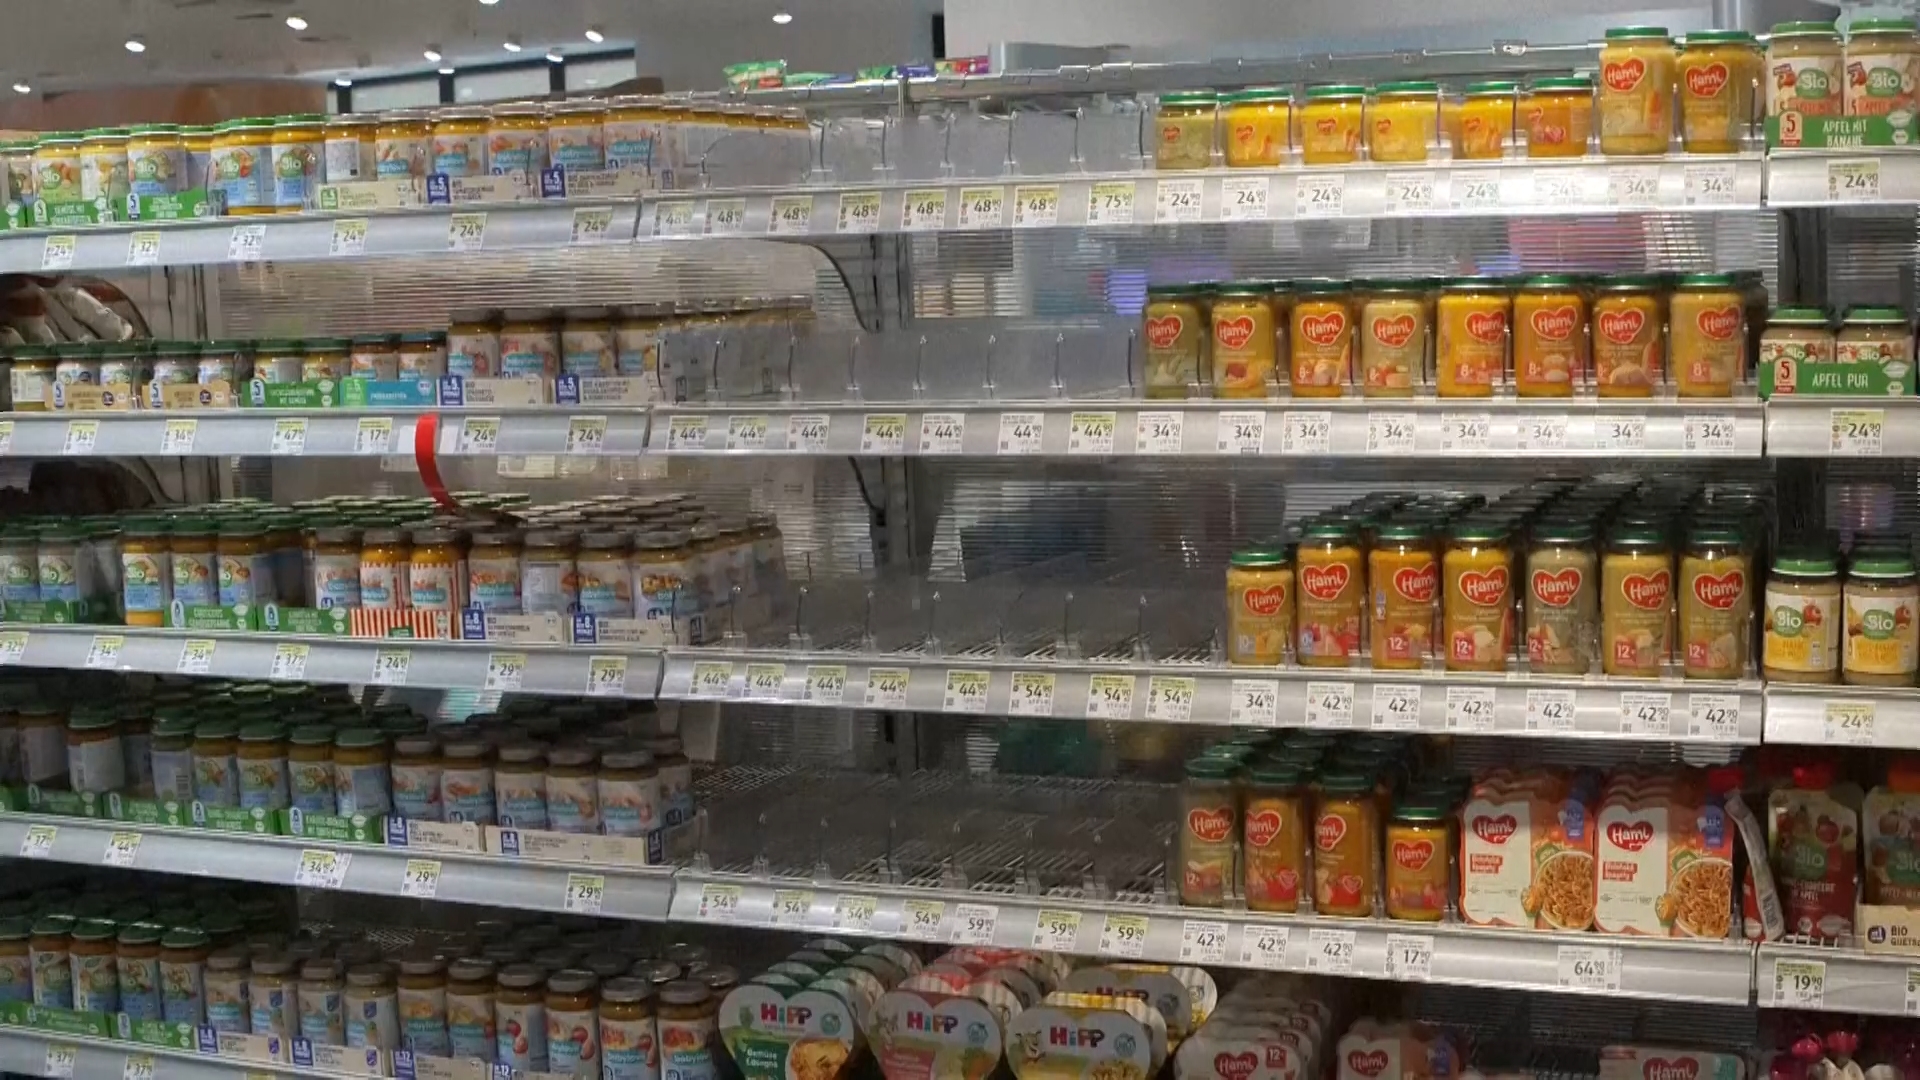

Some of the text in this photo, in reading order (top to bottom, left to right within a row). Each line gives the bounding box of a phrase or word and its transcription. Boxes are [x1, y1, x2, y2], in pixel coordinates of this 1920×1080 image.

[1608, 64, 1640, 84] Hami
[1689, 71, 1724, 91] Hami
[1871, 70, 1900, 89] Bio
[1786, 113, 1796, 134] 5
[1822, 120, 1850, 134] APFEL
[1306, 320, 1340, 337] Hami
[1377, 322, 1410, 338] Hami
[1538, 314, 1573, 332] Hami
[1604, 318, 1638, 334] Hami
[1780, 361, 1790, 379] 5
[1812, 374, 1868, 388] APFEL PUR
[1306, 571, 1344, 590] Hami
[1466, 575, 1504, 596] Hami
[1536, 576, 1576, 595] Hami
[1630, 581, 1667, 600] Hami
[1700, 580, 1740, 600] Hami
[1249, 592, 1282, 610] Hami
[1477, 819, 1514, 838] Hami
[1612, 826, 1650, 844] Hami
[1891, 926, 1908, 936] BIO
